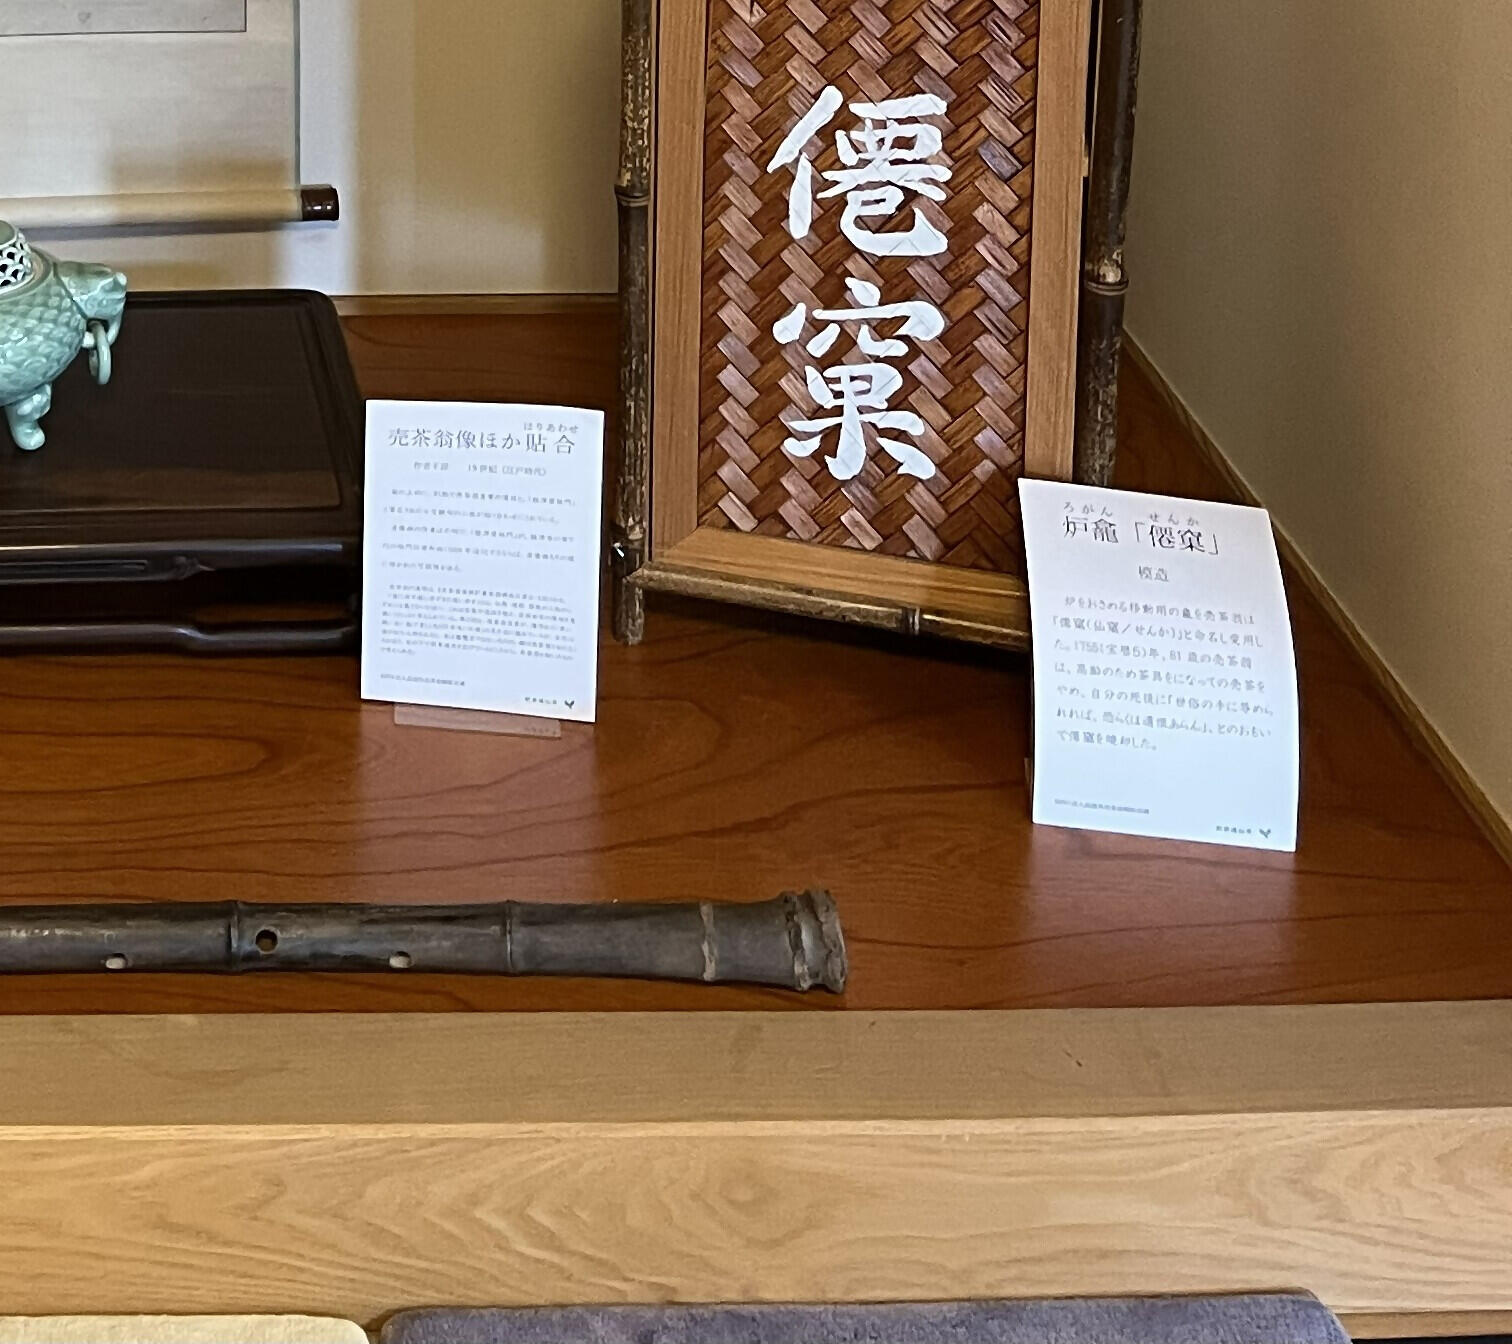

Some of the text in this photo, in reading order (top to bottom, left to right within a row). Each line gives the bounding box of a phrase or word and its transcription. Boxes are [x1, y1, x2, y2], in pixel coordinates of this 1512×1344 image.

[388, 428, 576, 454] 売茶翁像ほか貼合
